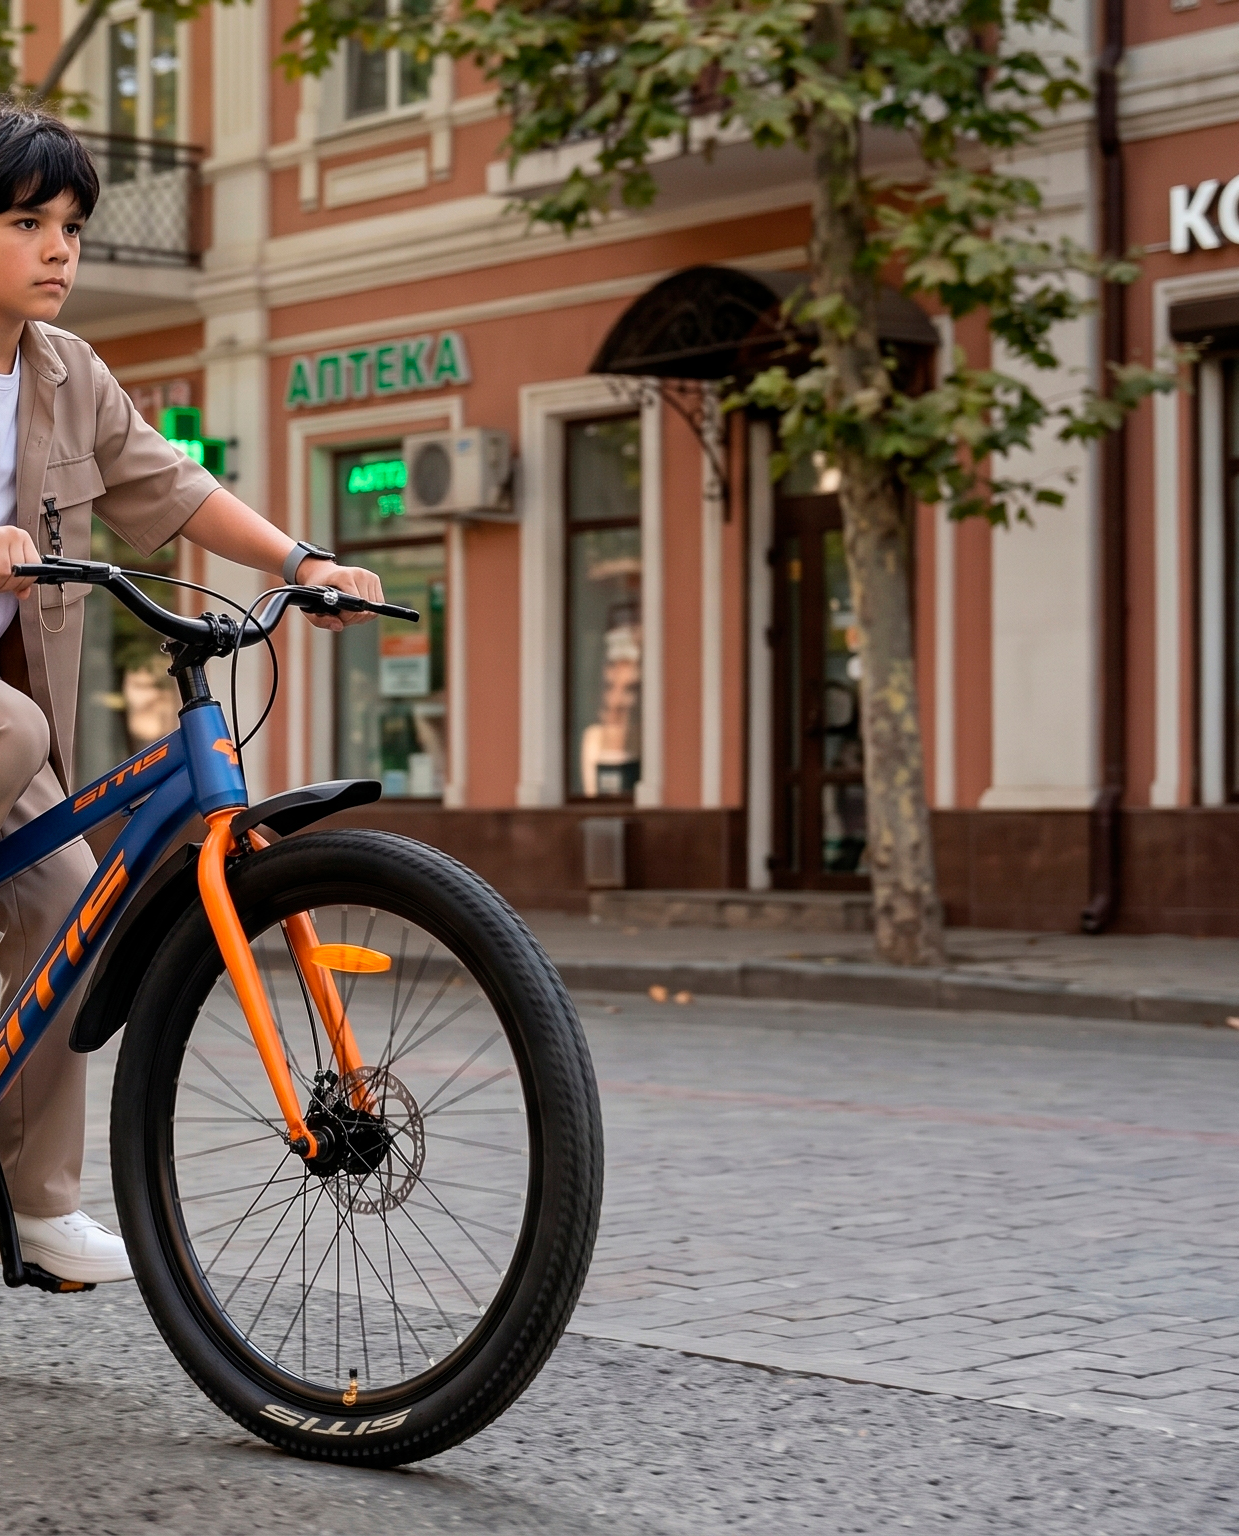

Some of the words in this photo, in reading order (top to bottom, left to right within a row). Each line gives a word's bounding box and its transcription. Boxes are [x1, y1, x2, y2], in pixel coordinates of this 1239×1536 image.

[286, 333, 467, 408] АПТЕКА
[73, 743, 169, 814] SITIS
[260, 1404, 412, 1436] SITIS
